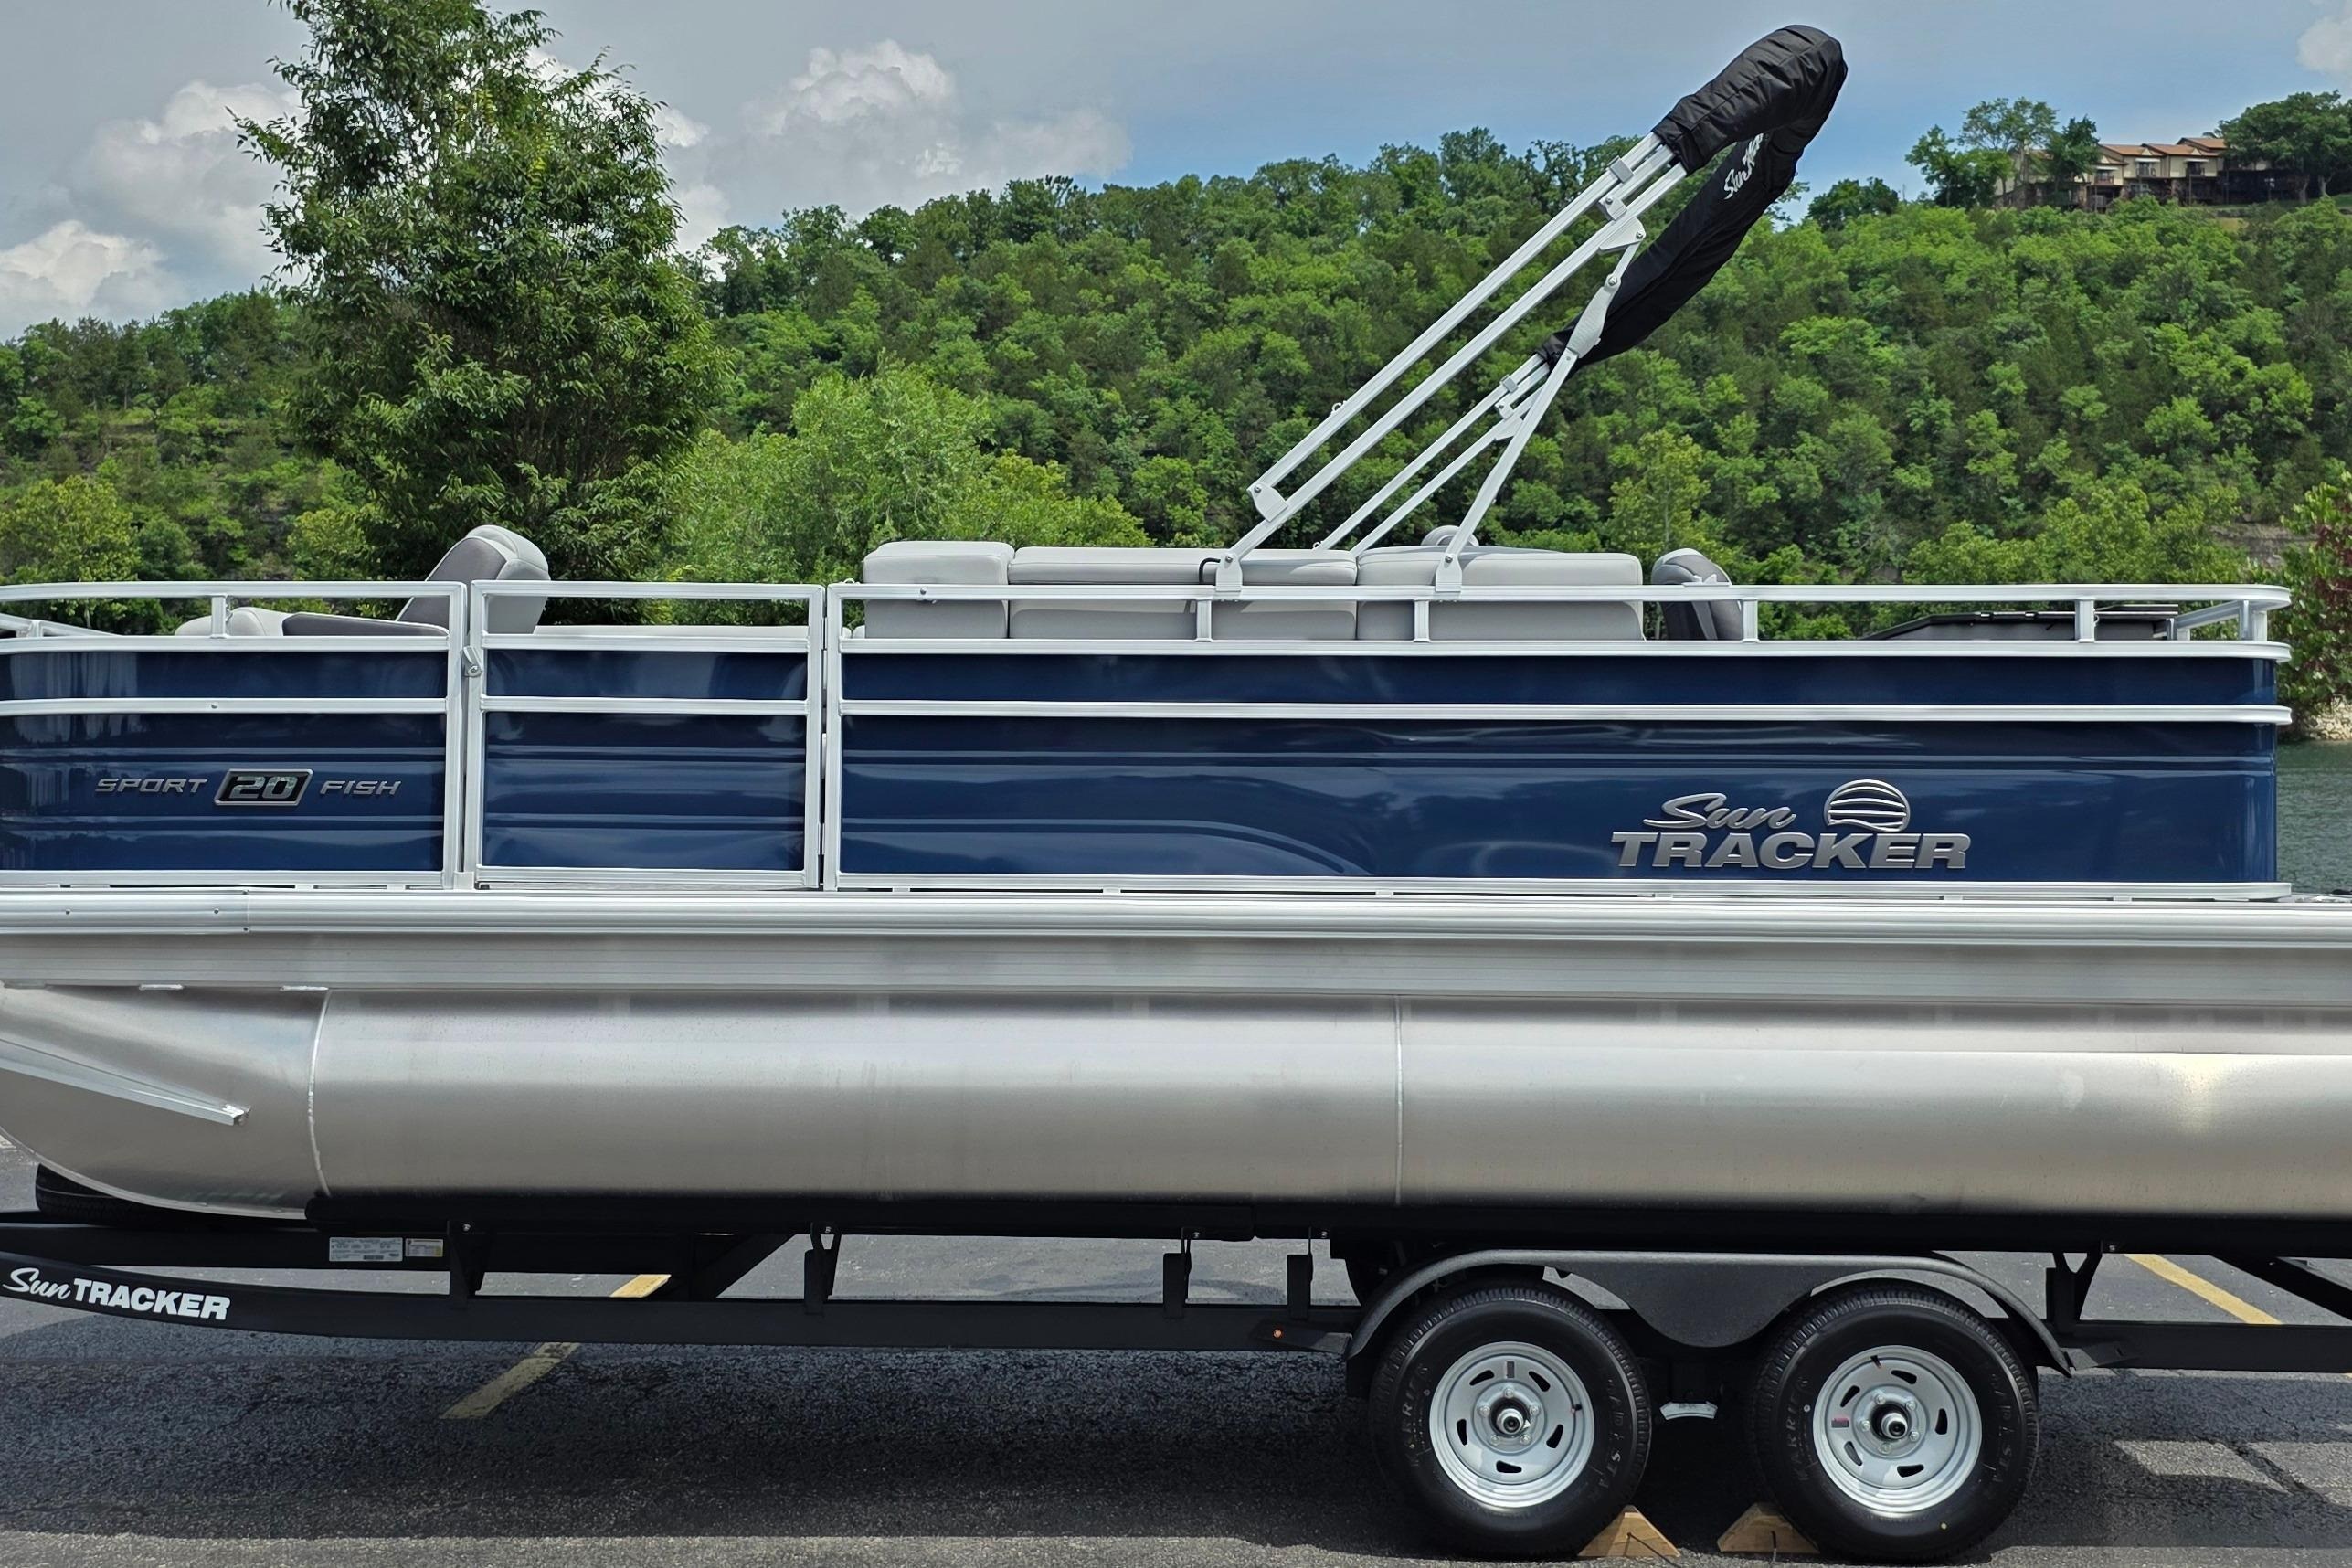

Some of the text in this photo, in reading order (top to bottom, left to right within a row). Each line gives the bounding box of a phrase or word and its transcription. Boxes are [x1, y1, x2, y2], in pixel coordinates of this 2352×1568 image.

[95, 775, 402, 800] SPORT 20 FISH
[1643, 792, 1797, 830] Sun
[1610, 831, 1972, 870] TRACKER
[2, 1267, 231, 1321] Sun TRACKER
